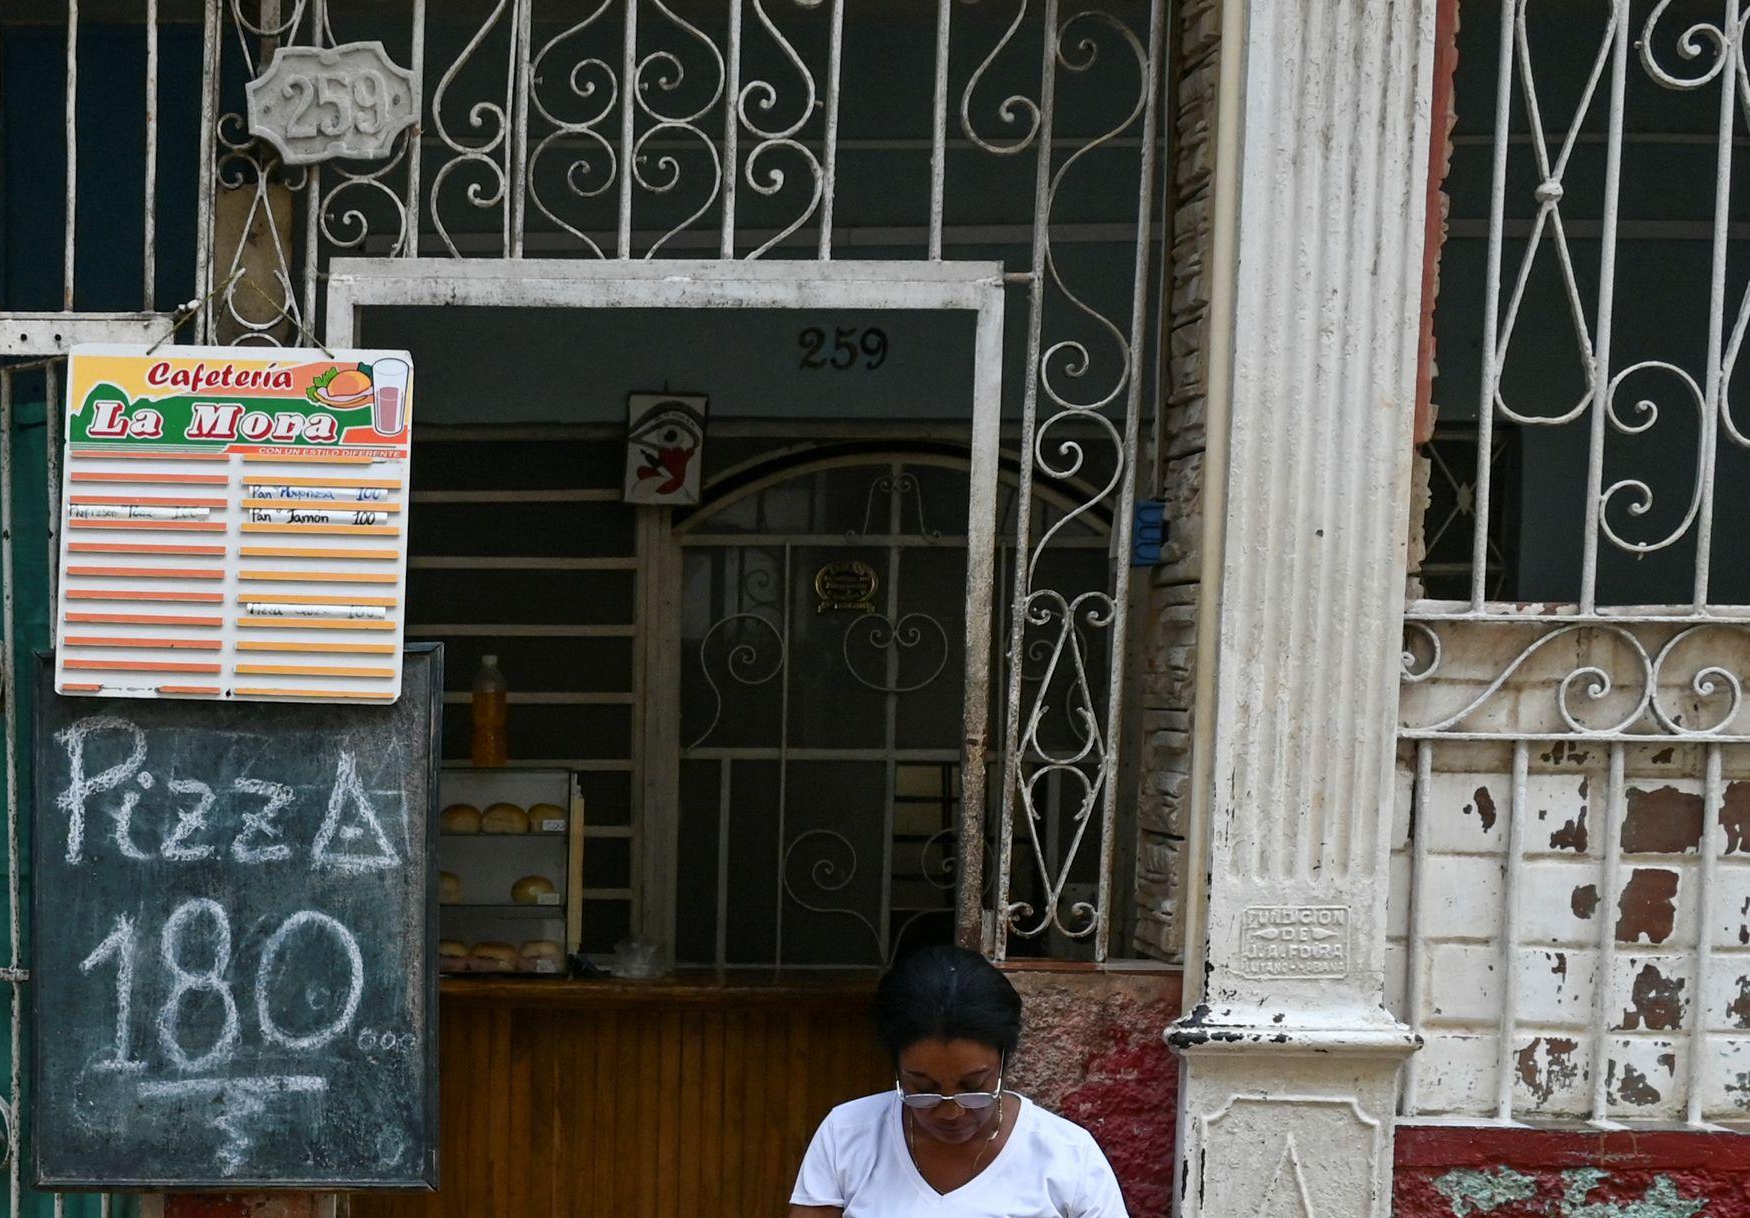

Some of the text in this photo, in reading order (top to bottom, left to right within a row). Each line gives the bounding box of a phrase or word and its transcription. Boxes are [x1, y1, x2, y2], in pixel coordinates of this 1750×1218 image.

[282, 69, 390, 139] 259
[798, 326, 889, 371] 259
[147, 361, 293, 393] Cafetería
[87, 400, 163, 439] La
[302, 449, 340, 457] ESTILO
[341, 450, 401, 459] DIFERENTE
[252, 508, 272, 522] Pan
[352, 511, 376, 526] 100
[1281, 928, 1308, 942] DE
[79, 896, 365, 1073] 180
